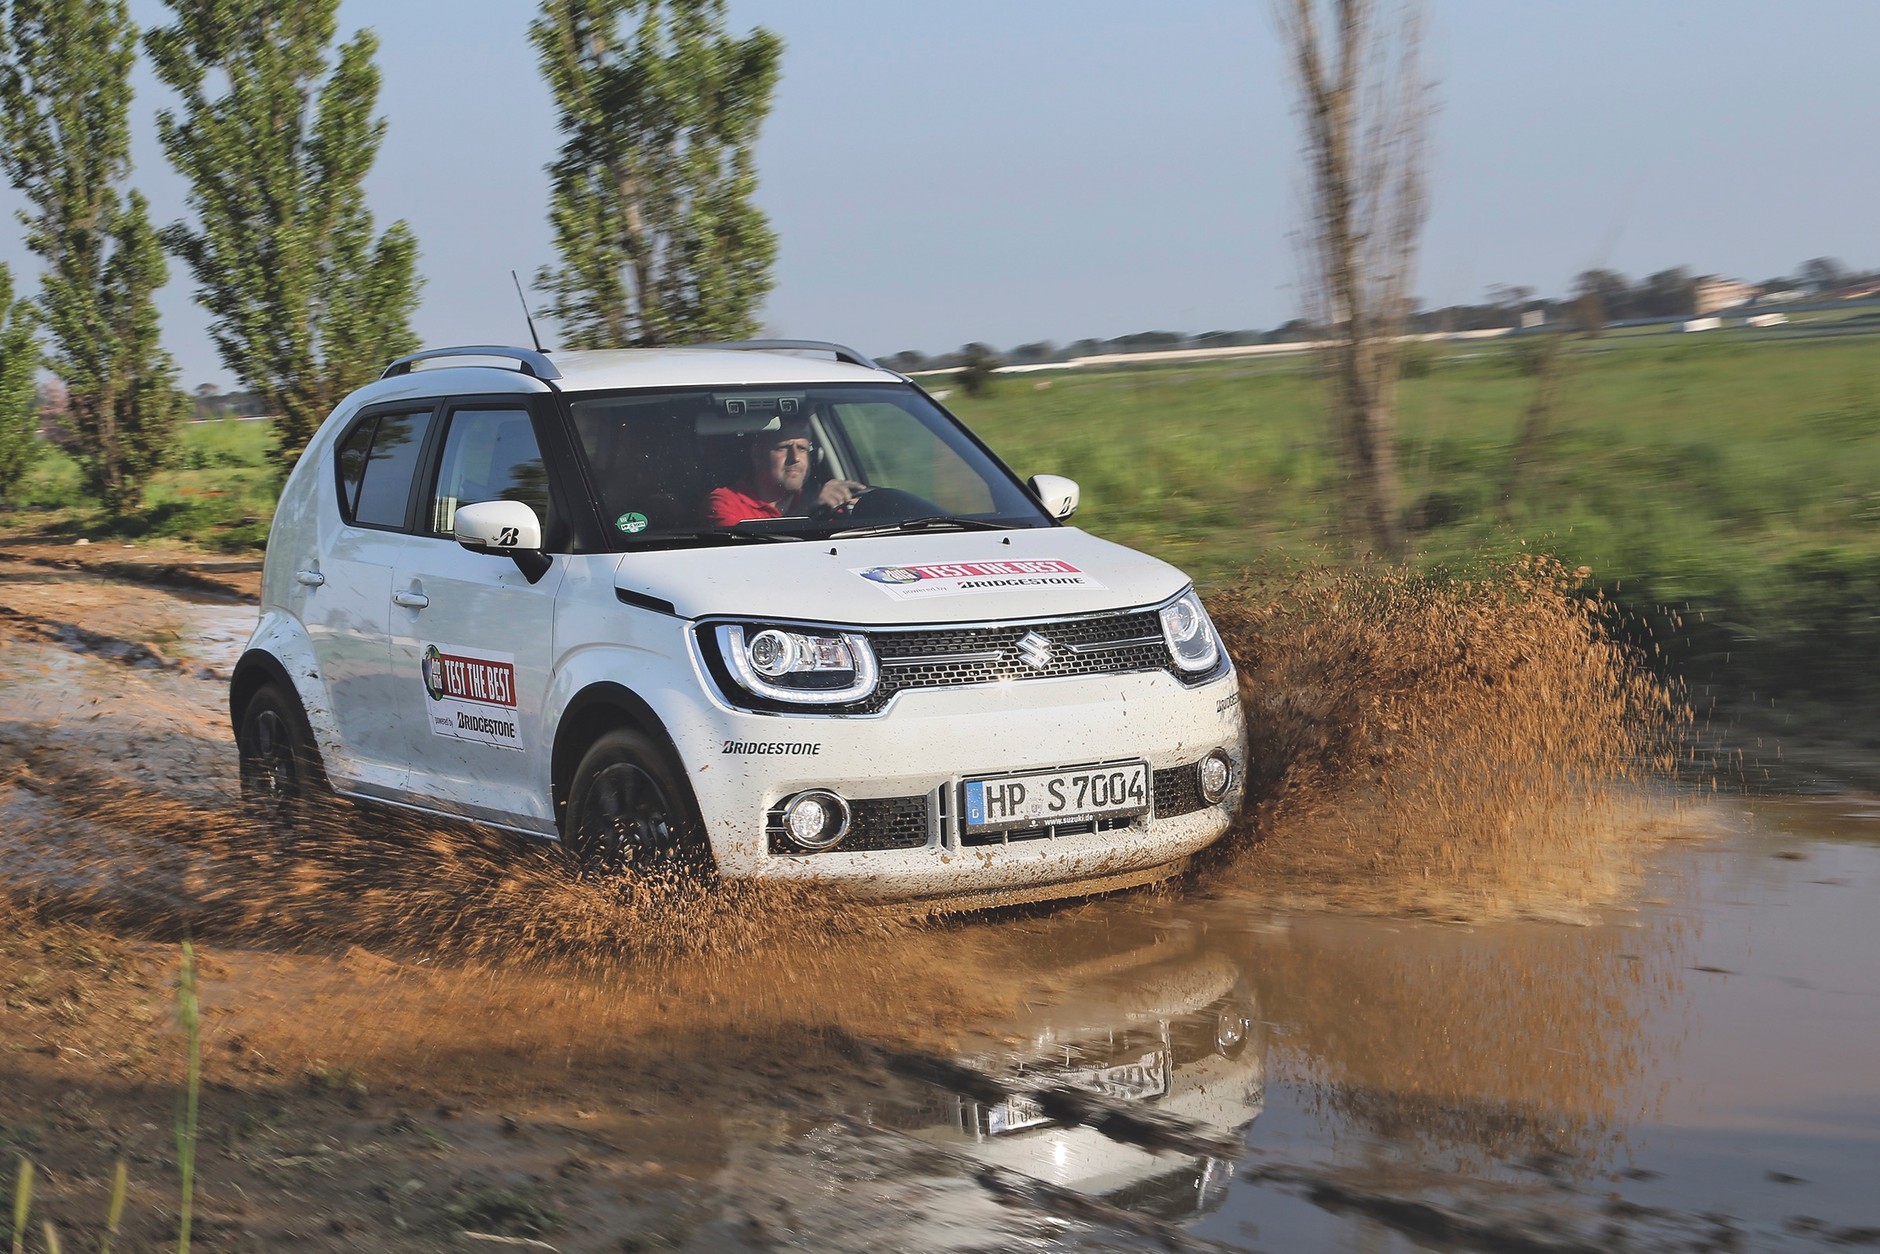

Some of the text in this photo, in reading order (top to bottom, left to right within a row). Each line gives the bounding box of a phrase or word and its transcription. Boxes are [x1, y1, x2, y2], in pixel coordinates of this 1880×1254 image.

[627, 512, 636, 522] 4
[498, 527, 520, 546] B
[917, 561, 1069, 578] TEST THE BEST
[956, 577, 1086, 589] BRIDGESTONE
[902, 587, 935, 596] powered
[444, 661, 511, 703] TEST THE BEST
[457, 712, 515, 738] BRIDGESTONE
[721, 740, 822, 755] BRIDGESTONE
[986, 770, 1145, 819] HP S 7004
[971, 808, 980, 819] D
[1044, 814, 1093, 826] www.suzuki.de
